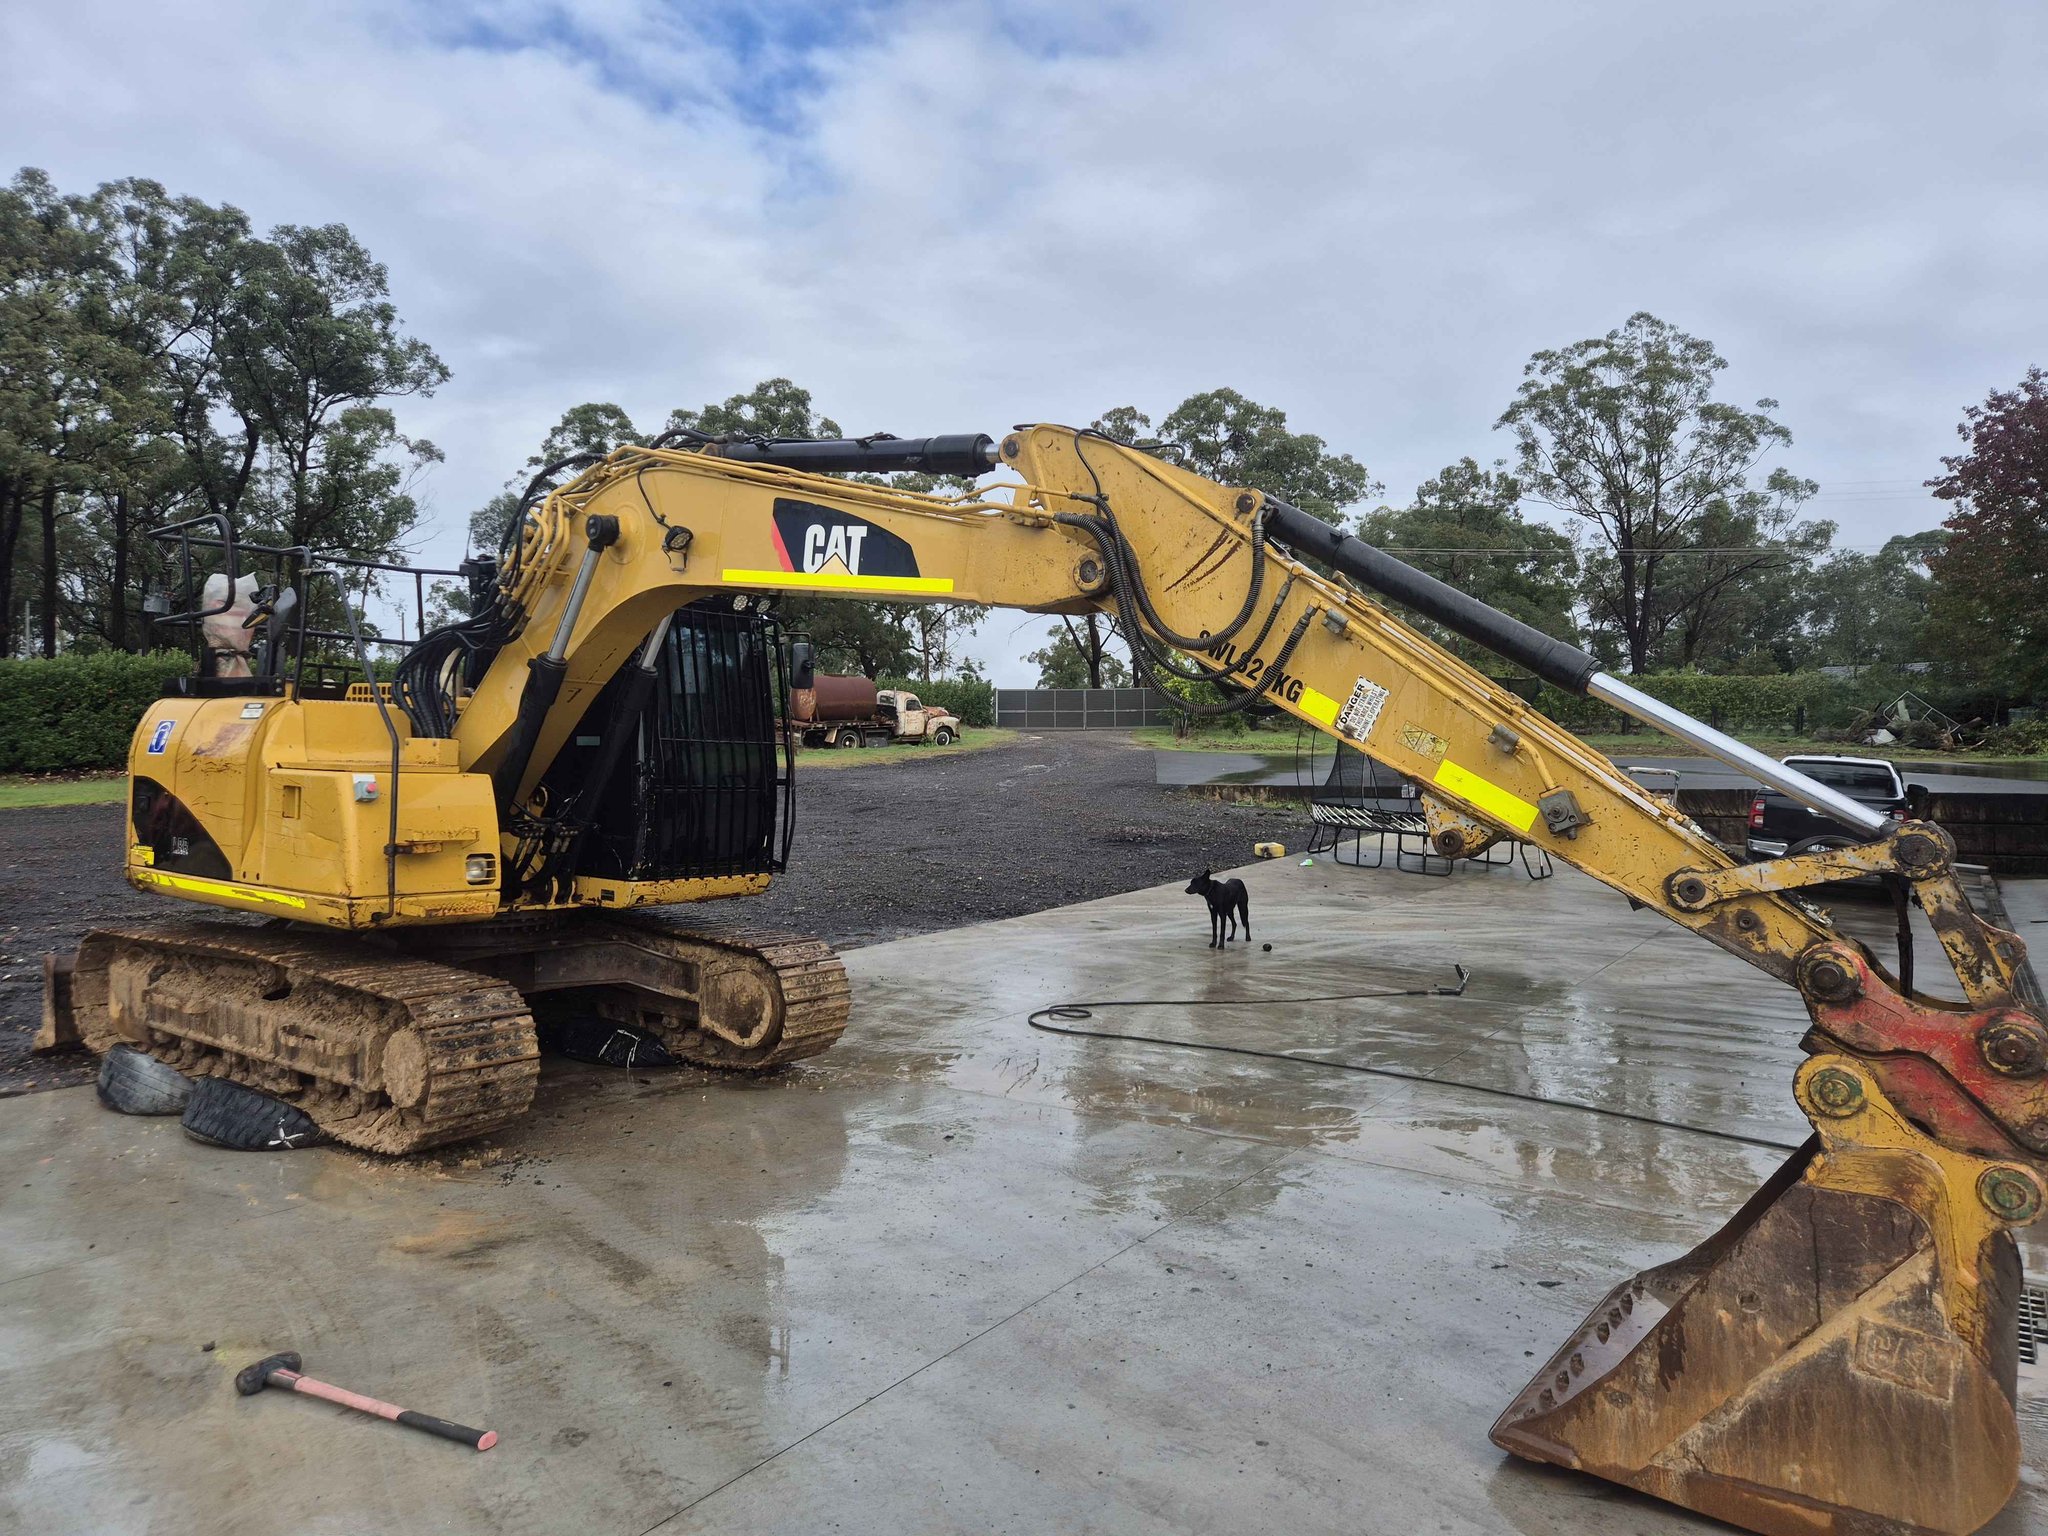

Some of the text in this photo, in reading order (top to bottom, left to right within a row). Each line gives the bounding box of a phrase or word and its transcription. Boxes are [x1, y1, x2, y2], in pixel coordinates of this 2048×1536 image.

[803, 524, 868, 575] CAT
[1340, 684, 1365, 724] DANGER
[1355, 689, 1379, 727] THIS AREA WHILST
[1357, 719, 1370, 738] MACHINE
[1370, 690, 1386, 715] OPERATING
